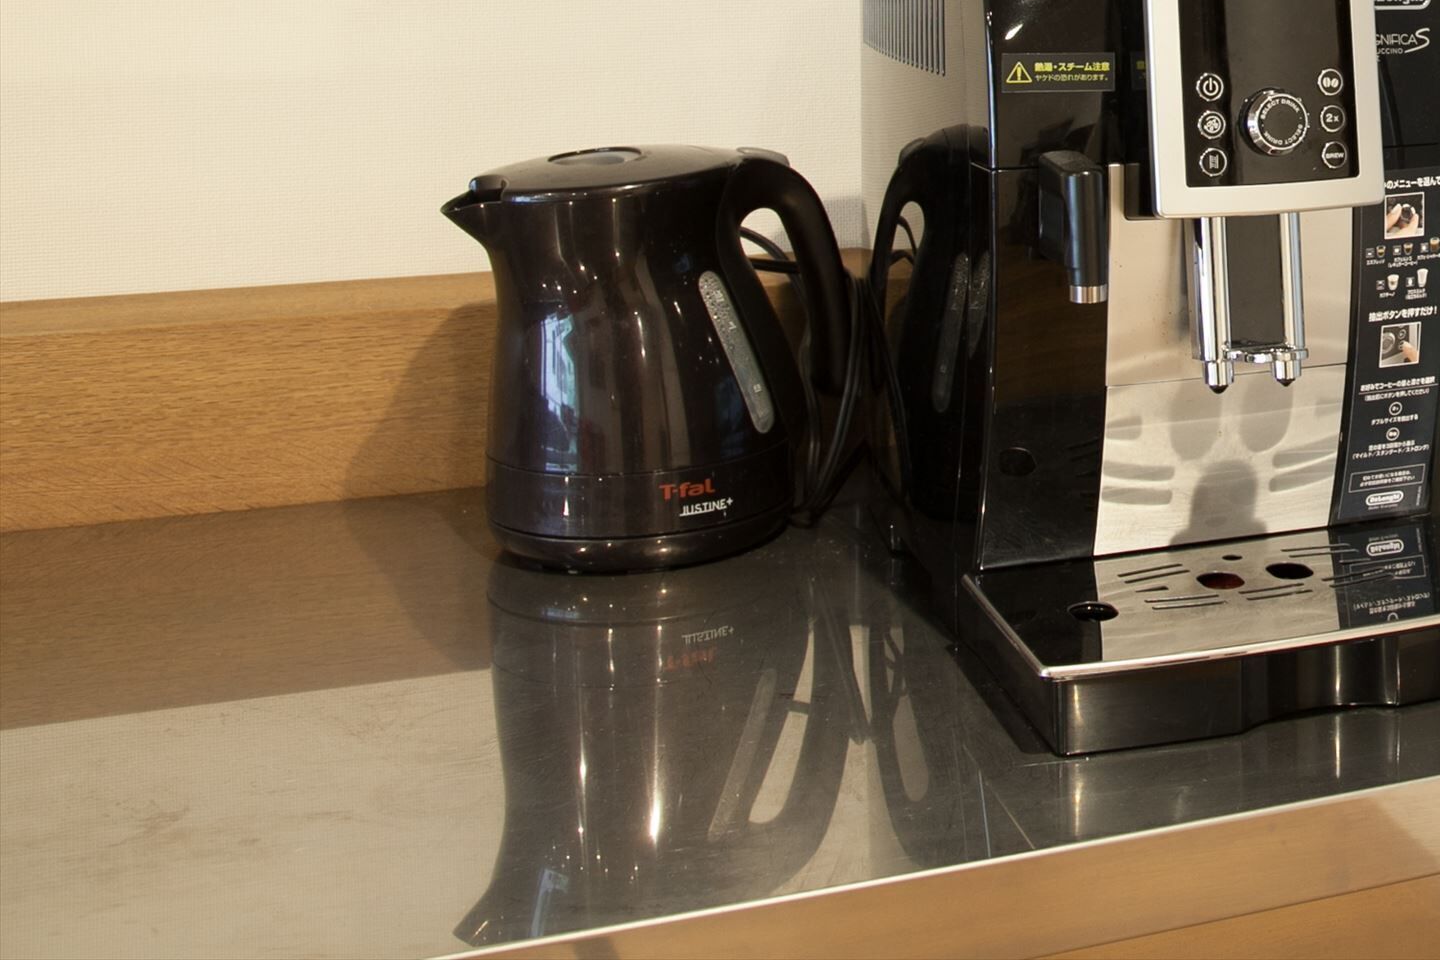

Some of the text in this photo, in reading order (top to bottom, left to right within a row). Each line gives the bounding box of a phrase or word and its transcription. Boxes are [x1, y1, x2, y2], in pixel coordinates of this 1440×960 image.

[1260, 98, 1301, 120] SELECT DRINK
[1325, 113, 1339, 123] 2x
[1263, 123, 1303, 146] SELECT DRINK
[1325, 151, 1345, 160] BREW
[659, 478, 716, 501] T-fal
